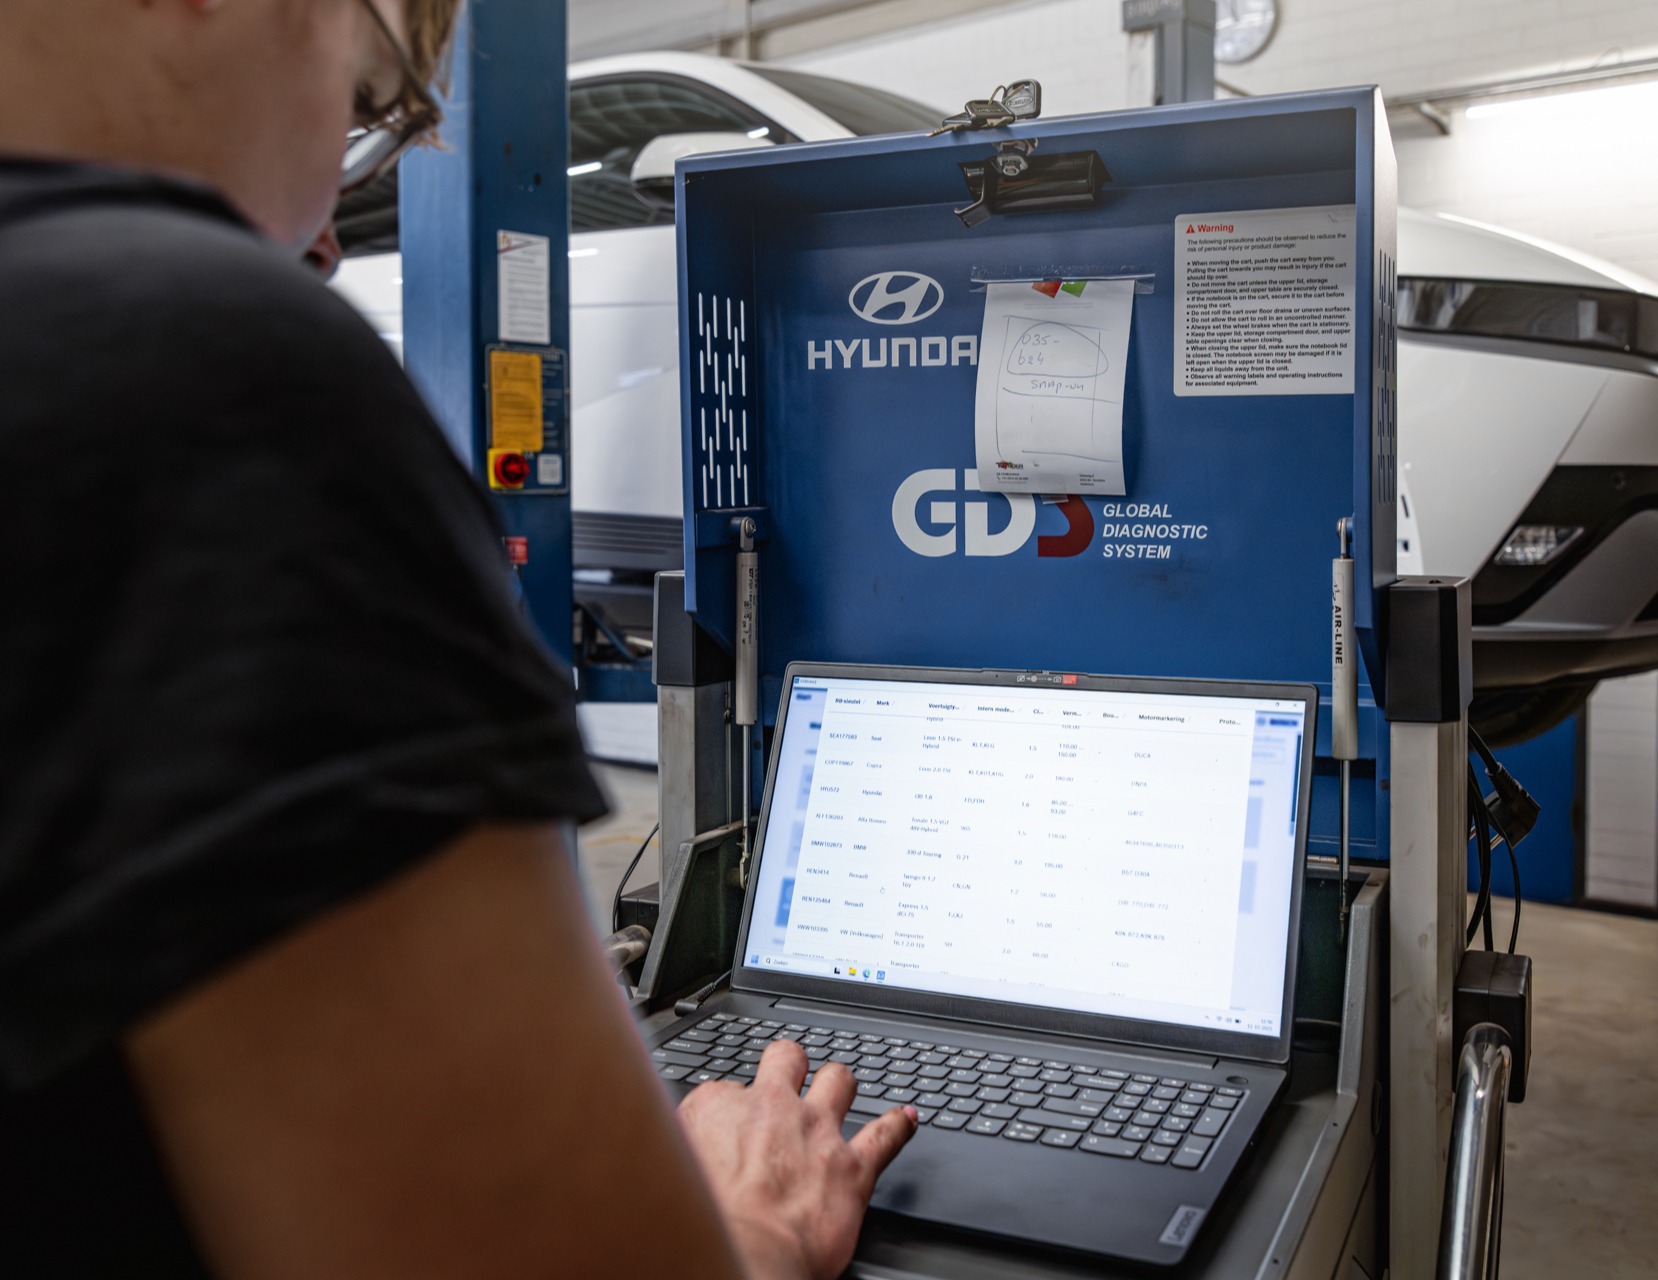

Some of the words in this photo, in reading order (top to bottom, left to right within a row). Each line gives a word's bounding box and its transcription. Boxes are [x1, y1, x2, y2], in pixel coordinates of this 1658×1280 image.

[1197, 223, 1234, 234] Warning
[1198, 238, 1222, 246] following
[1223, 236, 1254, 244] precautions
[1204, 245, 1227, 253] personal
[1251, 243, 1272, 251] product
[1273, 242, 1297, 250] damage:
[1186, 288, 1223, 296] compartment
[808, 335, 977, 370] HYUNDA
[1102, 504, 1172, 518] GLOBAL
[1102, 524, 1208, 540] DIAGNOSTIC
[1102, 544, 1171, 560] SYSTEM
[1334, 605, 1343, 664] AIR-LINE
[1138, 714, 1185, 723] Motormarkering
